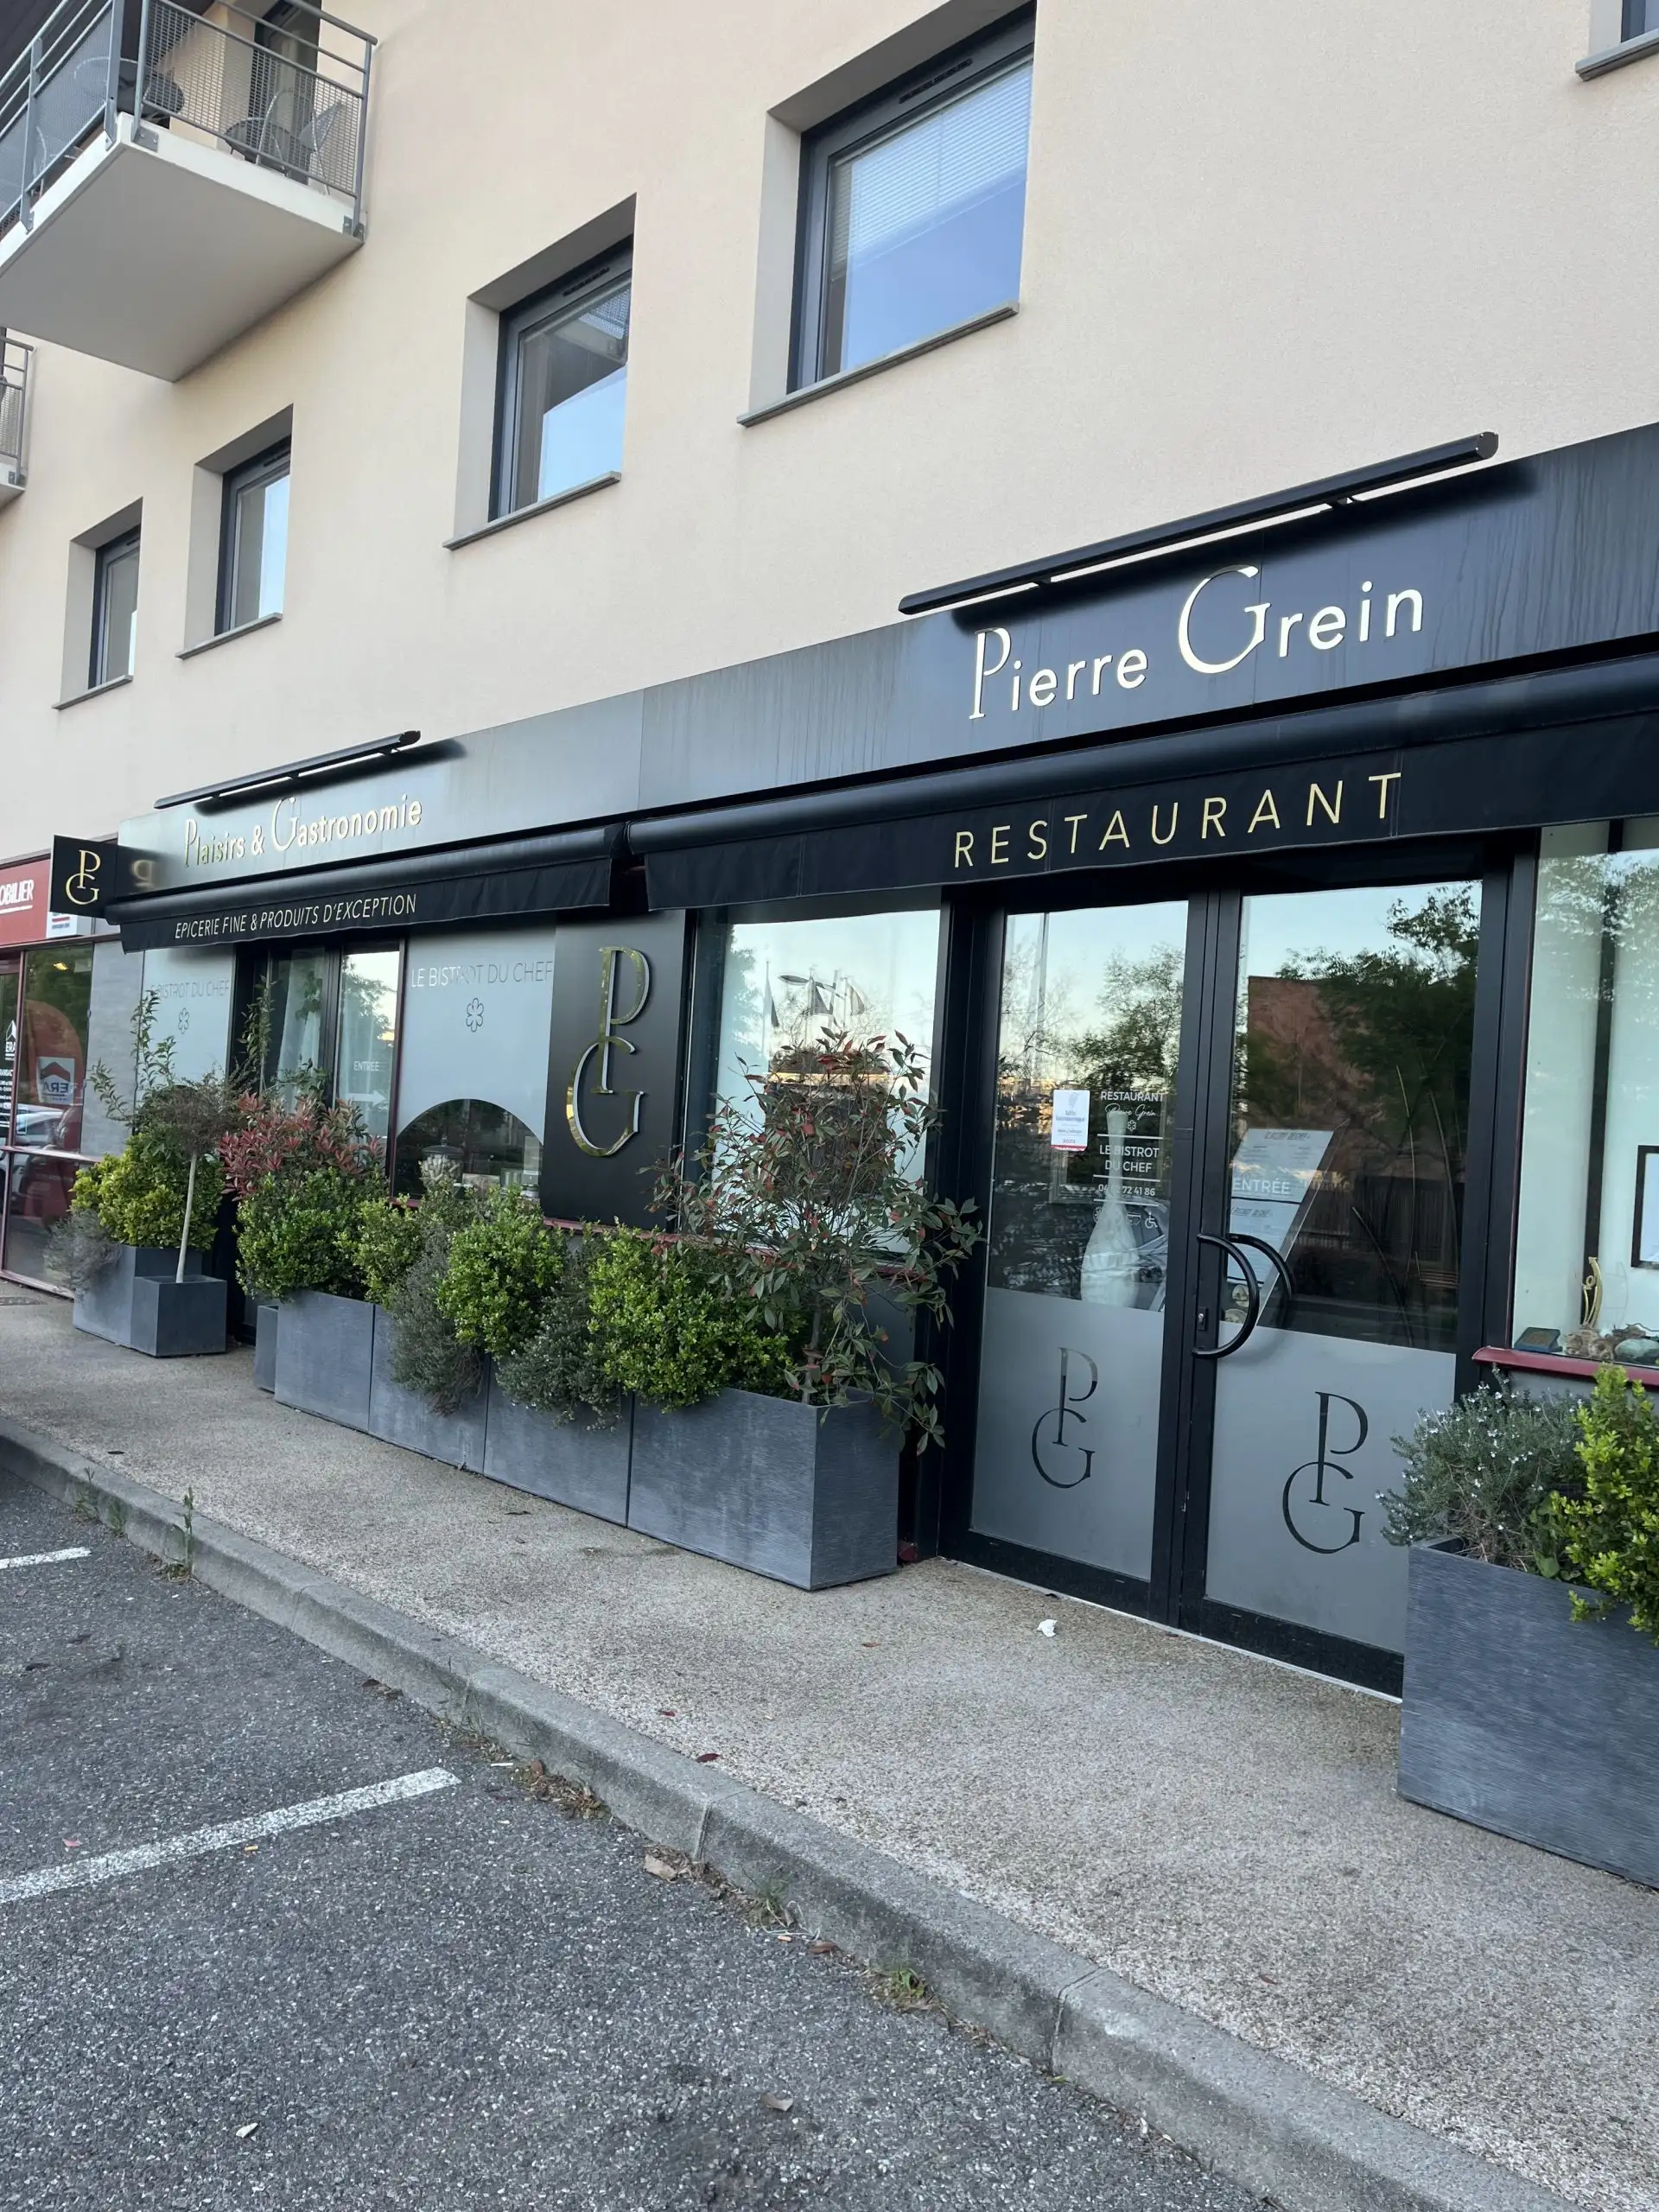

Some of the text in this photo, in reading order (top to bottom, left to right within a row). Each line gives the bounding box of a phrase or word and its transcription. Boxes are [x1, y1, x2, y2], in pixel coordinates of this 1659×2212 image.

[969, 564, 1424, 720] Pierre Grein
[954, 772, 1402, 868] RESTAURANT
[184, 794, 423, 868] Plaisirs & Gastronomie
[175, 893, 417, 939] EPICERIE FINE & PRODUITS D'EXCEPTION
[411, 960, 554, 988] LE BISTROT DU CHEF
[191, 982, 203, 998] DU
[207, 979, 230, 997] CHEF
[1100, 1090, 1164, 1102] RESTAURANT
[1099, 1144, 1160, 1159] LE BISTROT
[1104, 1160, 1153, 1173] DU CHEF
[1122, 1185, 1133, 1194] 72
[1134, 1186, 1143, 1195] 41
[1144, 1187, 1156, 1197] 86
[1232, 1177, 1292, 1195] ENTRÉE
